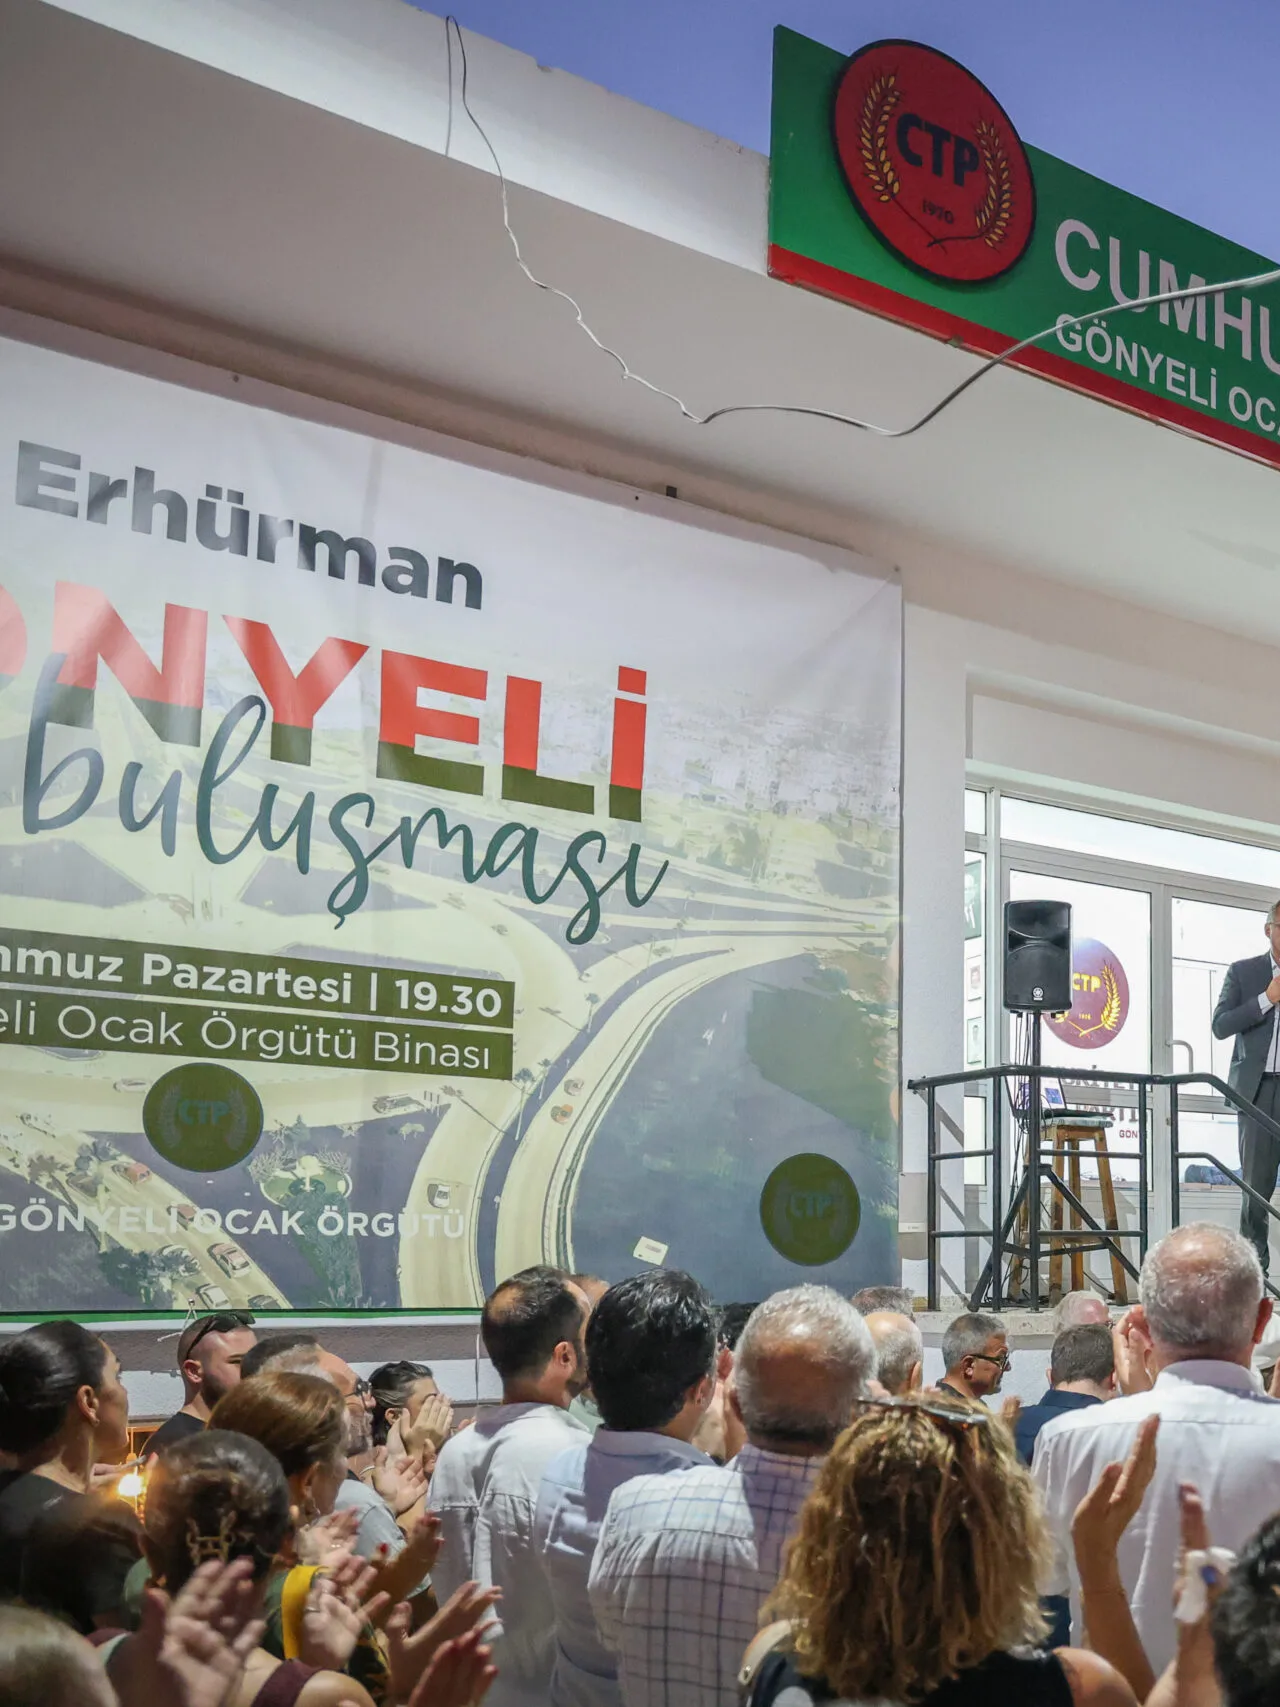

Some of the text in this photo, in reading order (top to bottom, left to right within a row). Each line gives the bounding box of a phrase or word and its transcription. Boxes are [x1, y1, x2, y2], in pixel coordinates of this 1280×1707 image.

[896, 113, 979, 187] CTP
[1055, 314, 1217, 409] GÖNYELİ
[15, 439, 483, 611] Erhürman
[0, 579, 647, 823] NYELİ
[22, 652, 670, 946] buluşması
[142, 952, 352, 1004] Pazartesi
[394, 978, 502, 1018] 19.30
[1072, 972, 1101, 993] CTP
[58, 1005, 183, 1046] Ocak
[201, 1010, 356, 1060] Örgütü
[374, 1031, 490, 1070] Binası
[193, 1207, 304, 1236] OCAK
[317, 1204, 465, 1239] ÖRGÜTÜ
